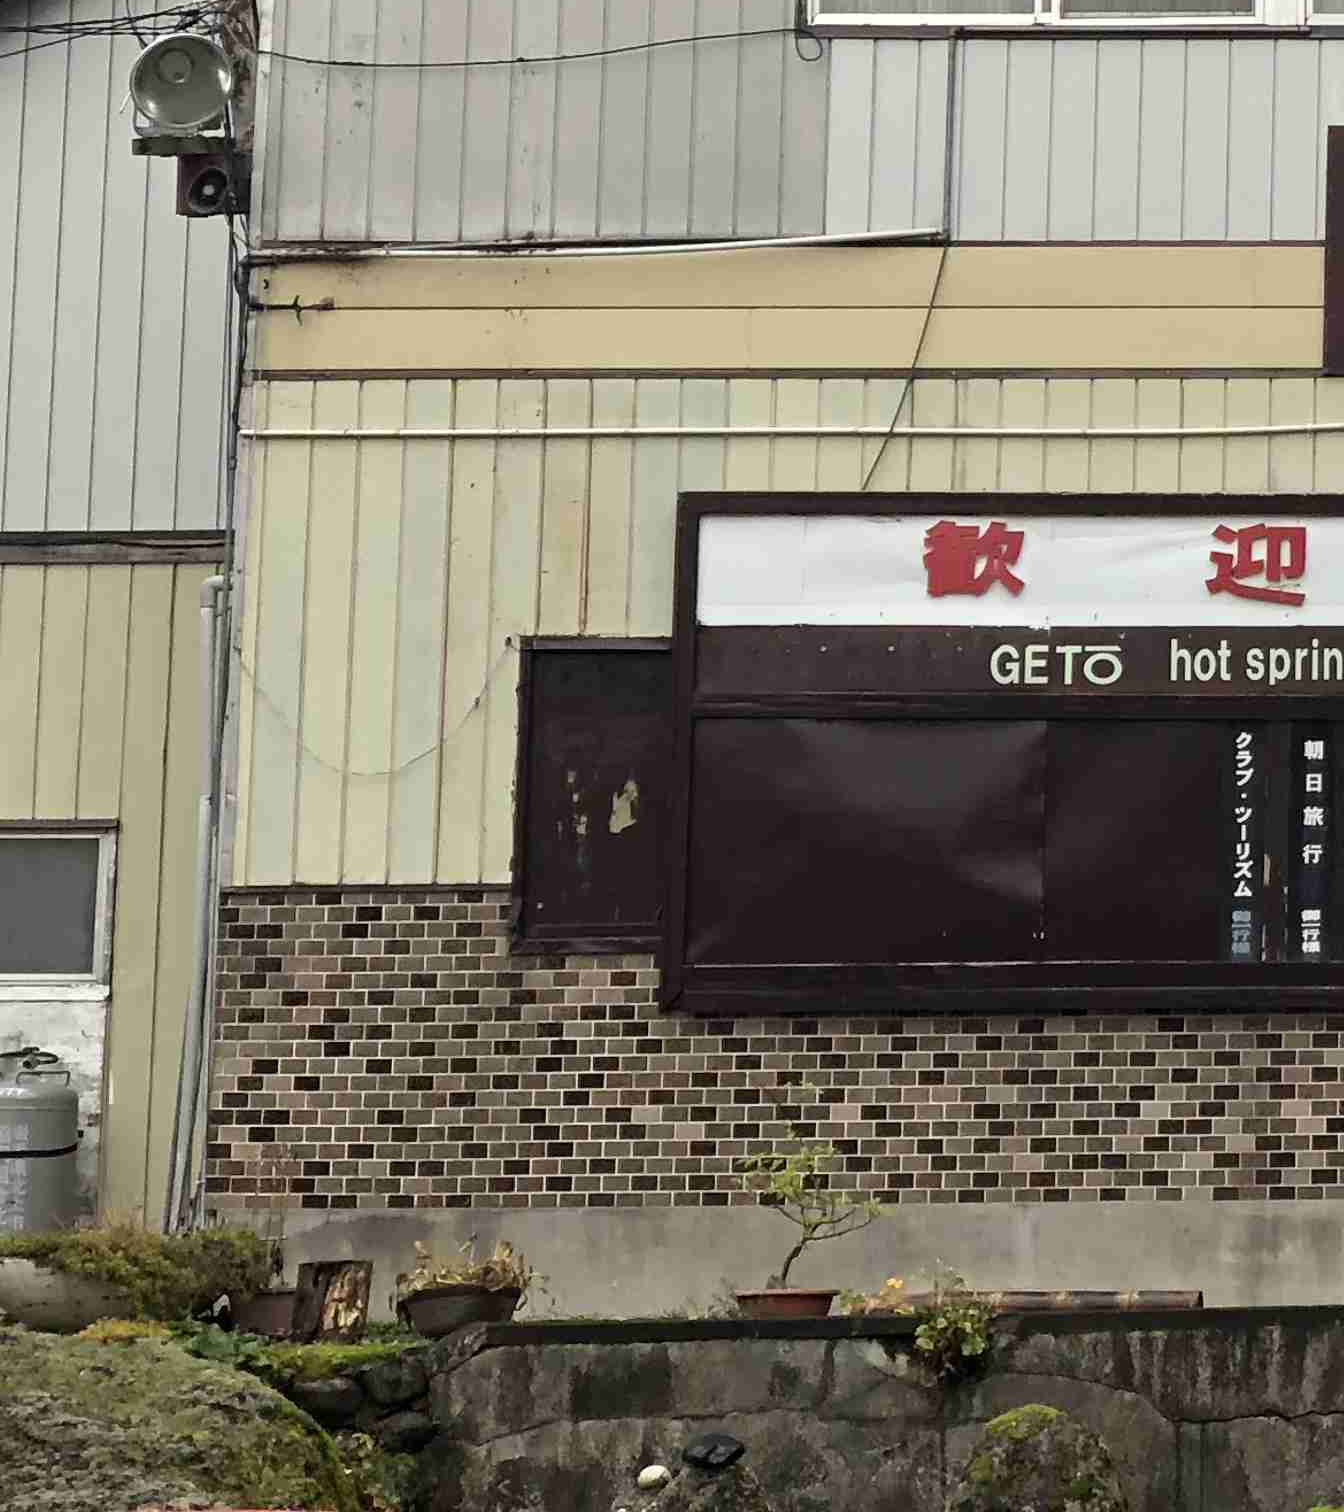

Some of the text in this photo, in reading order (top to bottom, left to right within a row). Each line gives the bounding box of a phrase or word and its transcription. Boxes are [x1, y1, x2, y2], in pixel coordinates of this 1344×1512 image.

[923, 520, 1306, 606] 歓迎
[1170, 639, 1232, 681] hot
[1302, 739, 1324, 865] 朝日旅行
